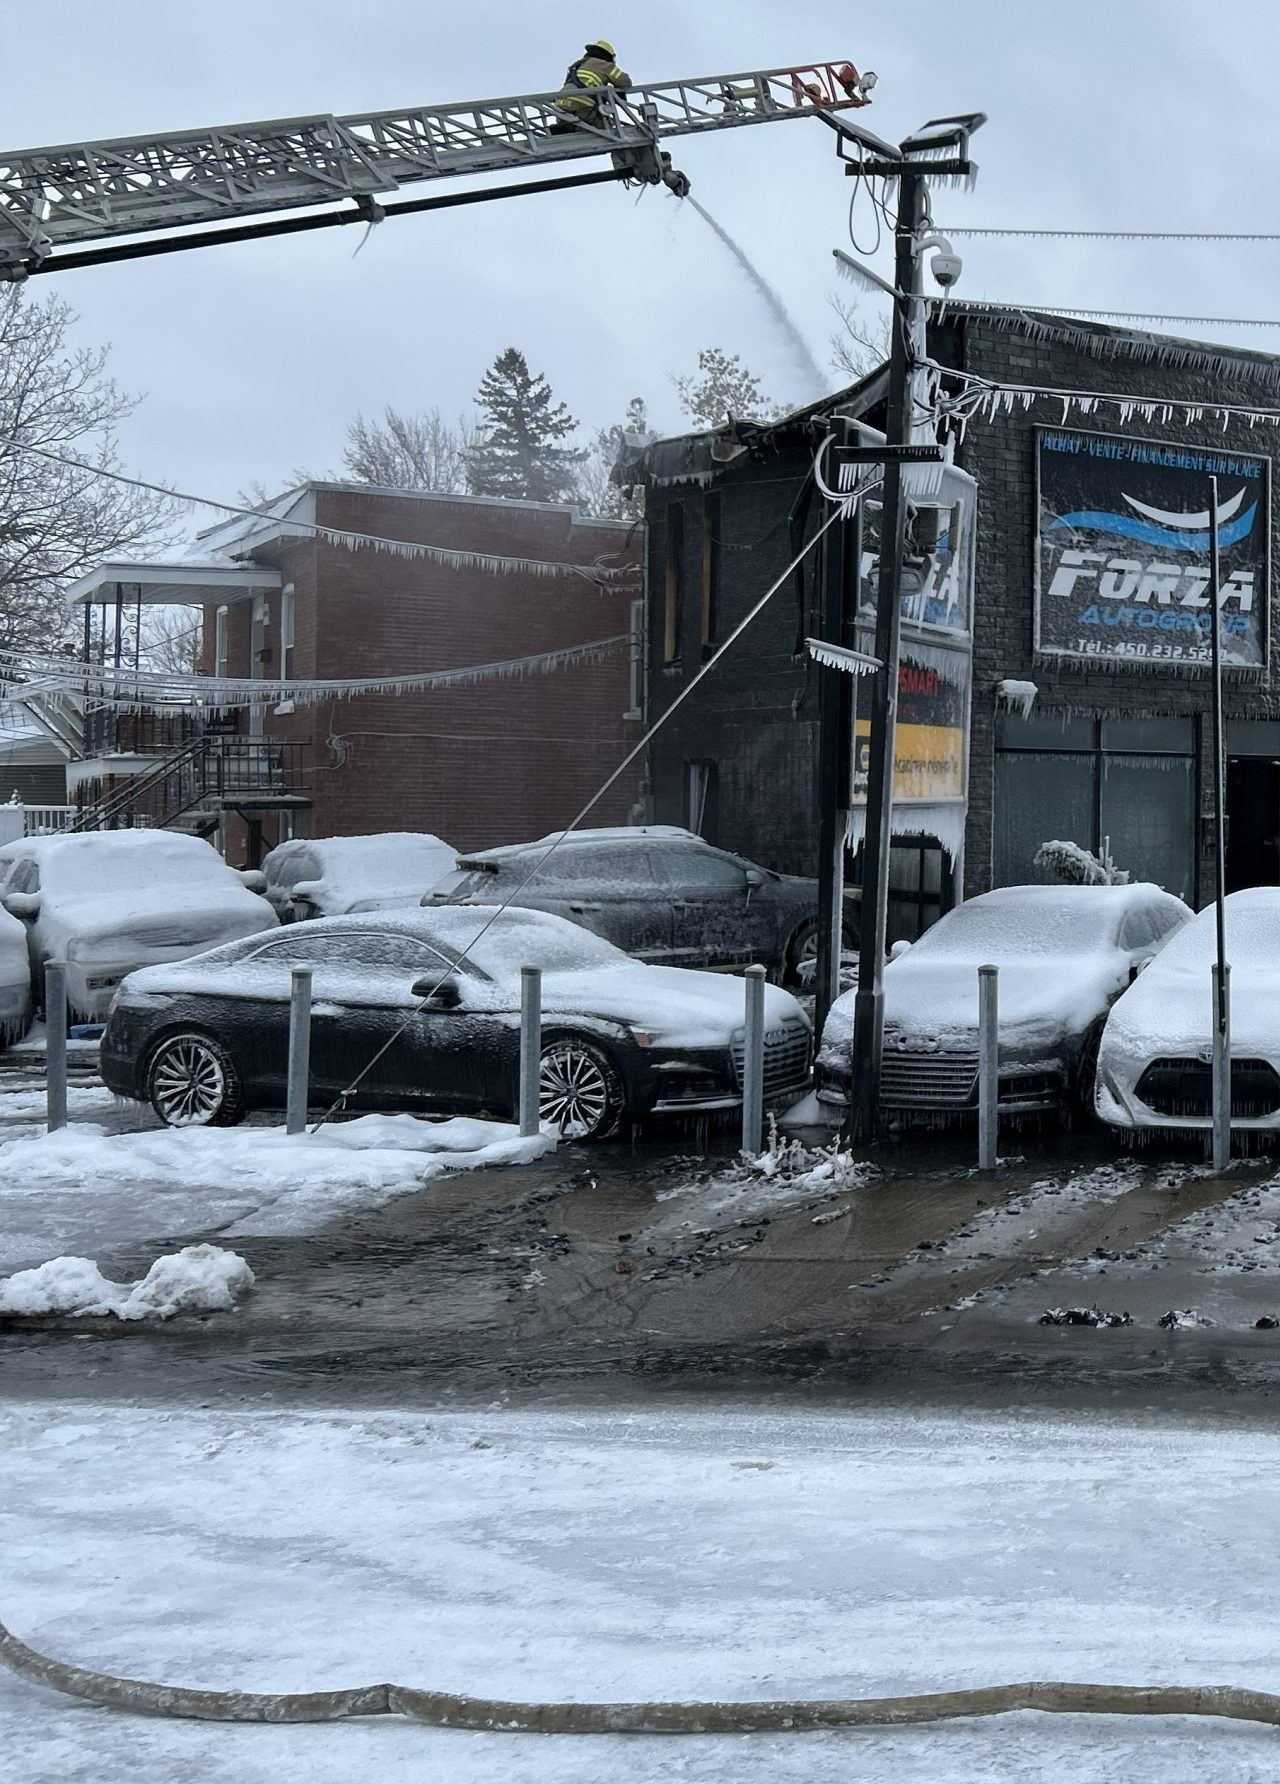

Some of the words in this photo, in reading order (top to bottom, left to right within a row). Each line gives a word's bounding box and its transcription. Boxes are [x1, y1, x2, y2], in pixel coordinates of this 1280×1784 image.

[1089, 442, 1124, 460] VENTE
[1131, 447, 1203, 471] FINANCEMENT
[1206, 459, 1227, 474] SUR
[1228, 461, 1261, 478] PLACE
[1048, 550, 1254, 611] FORZA
